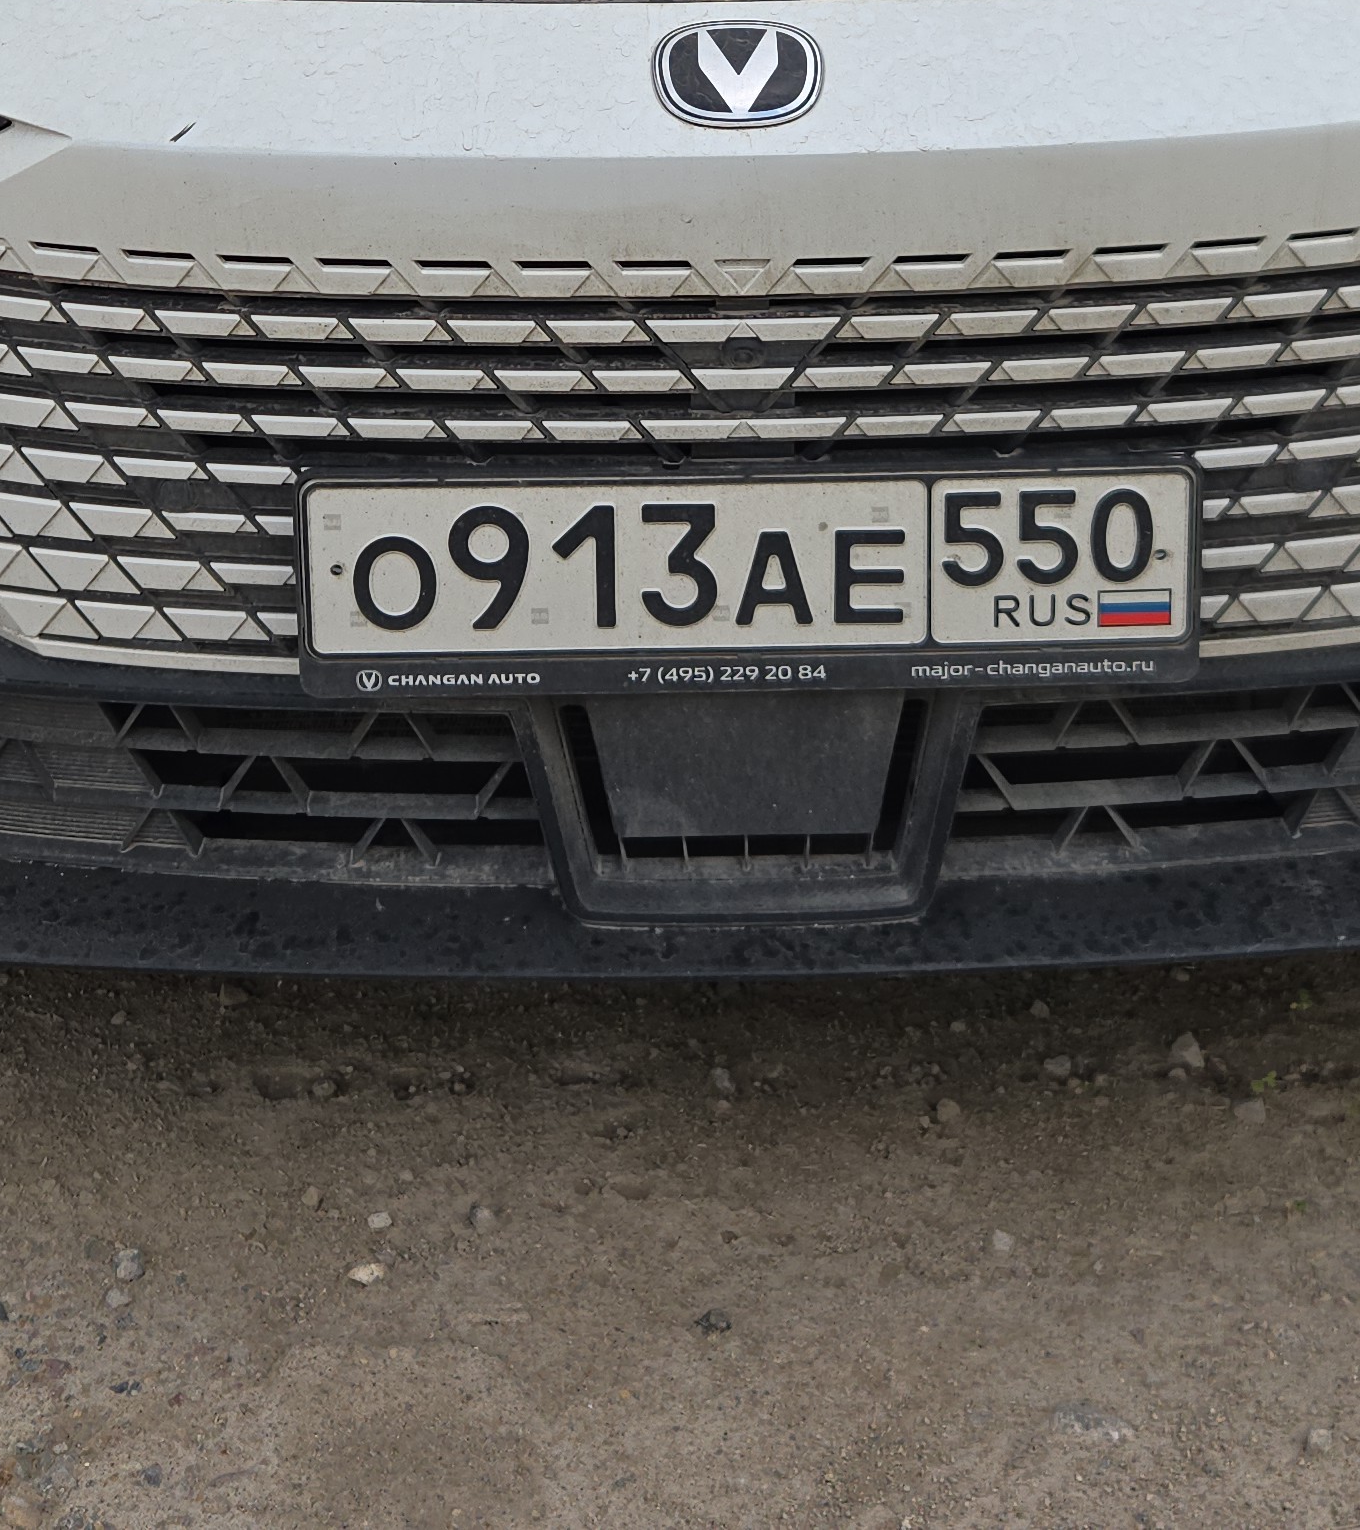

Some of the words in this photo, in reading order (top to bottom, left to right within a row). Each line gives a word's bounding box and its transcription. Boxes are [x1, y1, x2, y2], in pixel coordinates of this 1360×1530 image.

[942, 488, 1154, 586] 550
[993, 594, 1091, 628] RUS
[387, 673, 483, 687] CHANGAN
[488, 672, 541, 686] AUTO
[627, 667, 650, 682] +7
[657, 666, 714, 685] (495)
[720, 665, 759, 681] 229
[765, 665, 792, 680] 20
[798, 664, 827, 680] 84
[911, 659, 1155, 680] major-changanauto.ru
